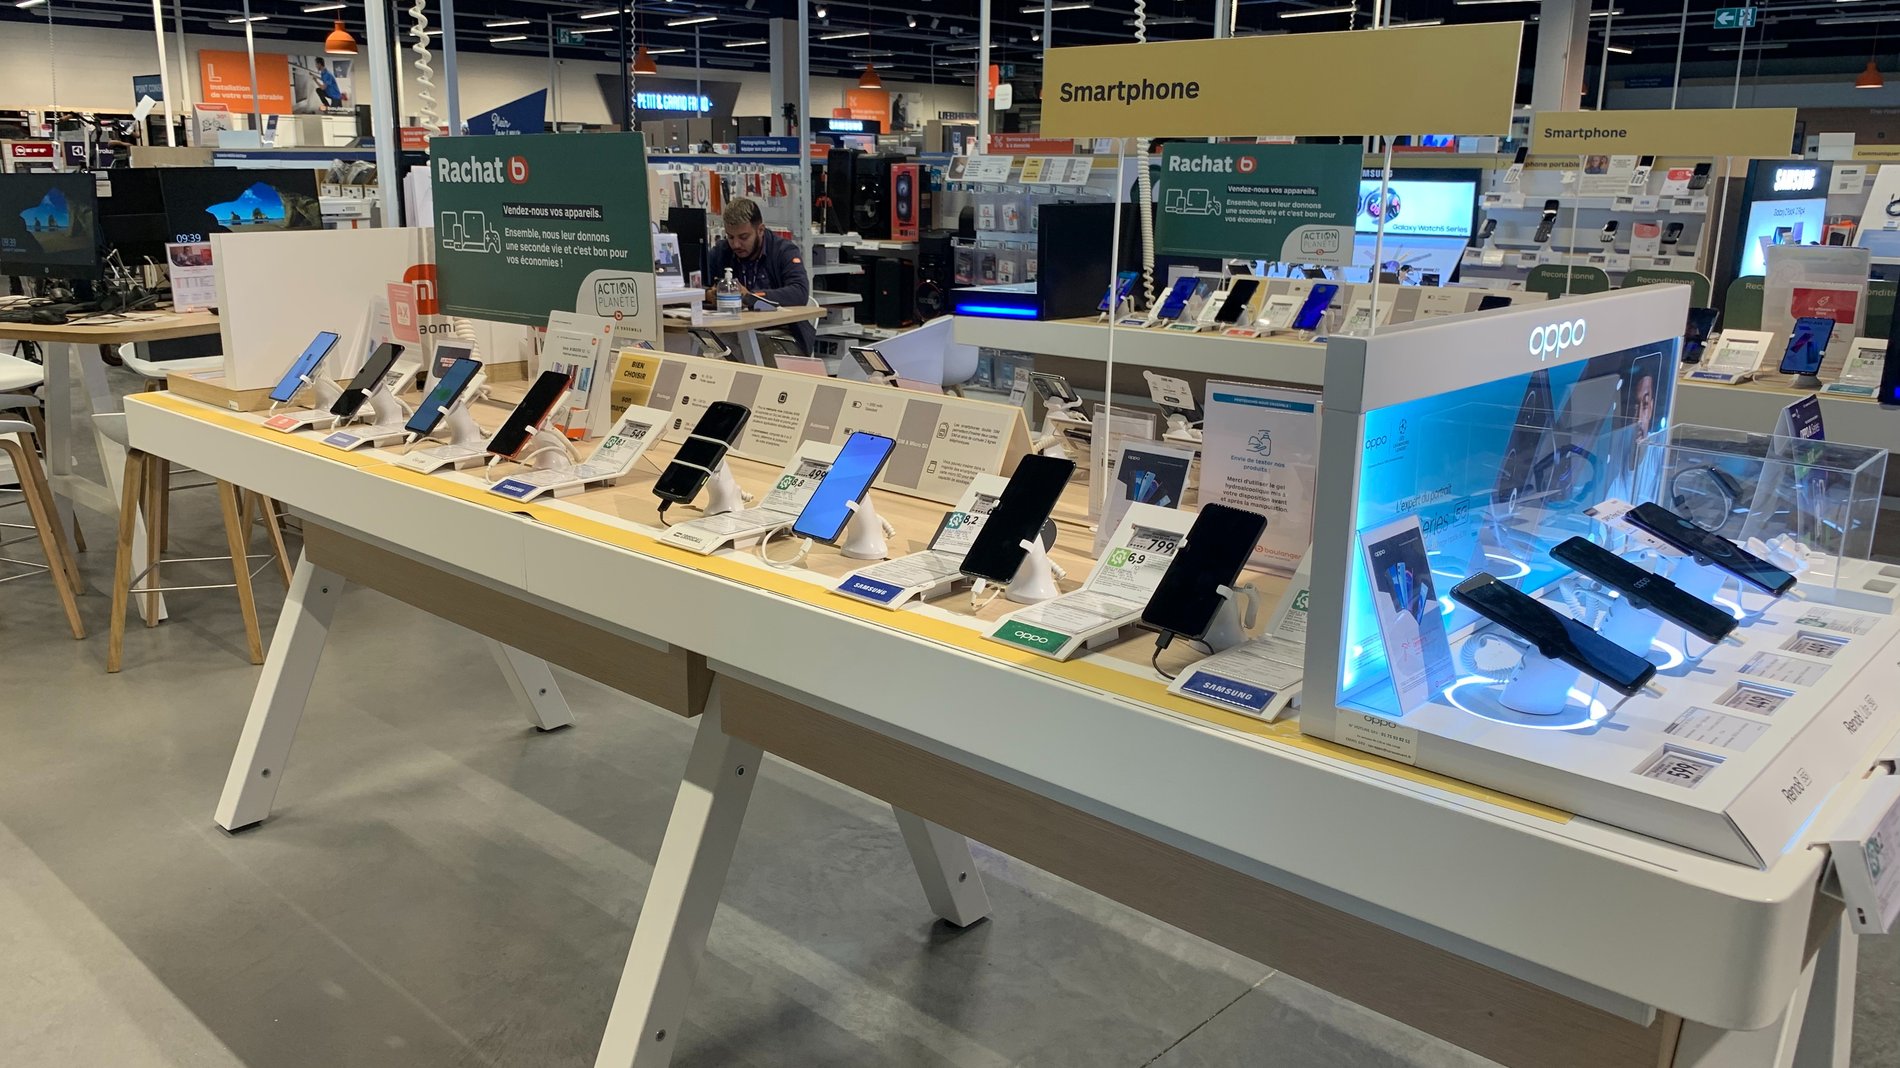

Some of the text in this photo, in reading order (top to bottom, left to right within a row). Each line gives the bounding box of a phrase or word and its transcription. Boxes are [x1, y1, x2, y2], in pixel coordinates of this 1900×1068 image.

[209, 84, 251, 92] Installation
[1059, 78, 1200, 106] Smartphone
[687, 95, 710, 112] FRID
[1543, 126, 1628, 142] Smartphone
[438, 155, 505, 184] Rachat
[1168, 155, 1233, 173] Rachat
[1226, 199, 1260, 208] Ensemble,
[503, 205, 602, 220] Vendez-nous vos appareils.
[1237, 216, 1272, 224] économies
[1392, 224, 1417, 232] Galaxy
[176, 234, 202, 244] 09:39
[504, 228, 610, 242] Ensemble, nous leur donnons
[1304, 232, 1337, 240] ACTION
[506, 242, 629, 260] une seconde vie et c'est bon pour
[506, 256, 520, 264] vos
[520, 256, 559, 268] économies
[1541, 270, 1595, 281] Recondtionné
[598, 282, 635, 296] ACTION
[419, 323, 456, 335] aomi
[1528, 318, 1586, 361] oppo
[631, 361, 646, 370] BIEN
[624, 370, 647, 380] CHOISIR
[630, 429, 647, 440] 549
[808, 468, 827, 480] 499
[1243, 464, 1268, 473] produits
[1244, 478, 1268, 487] d'utiliser
[1228, 498, 1244, 506] après
[1238, 492, 1270, 502] disposition
[962, 514, 979, 526] 8,2
[1147, 539, 1175, 554] 799
[1128, 552, 1146, 564] 6,9
[853, 582, 888, 596] SAMSUNG
[1014, 630, 1048, 644] oppo
[1202, 681, 1254, 701] SAMSUNG
[1364, 714, 1397, 728] oppo
[1666, 762, 1698, 779] 599
[1782, 776, 1802, 804] Reno8
